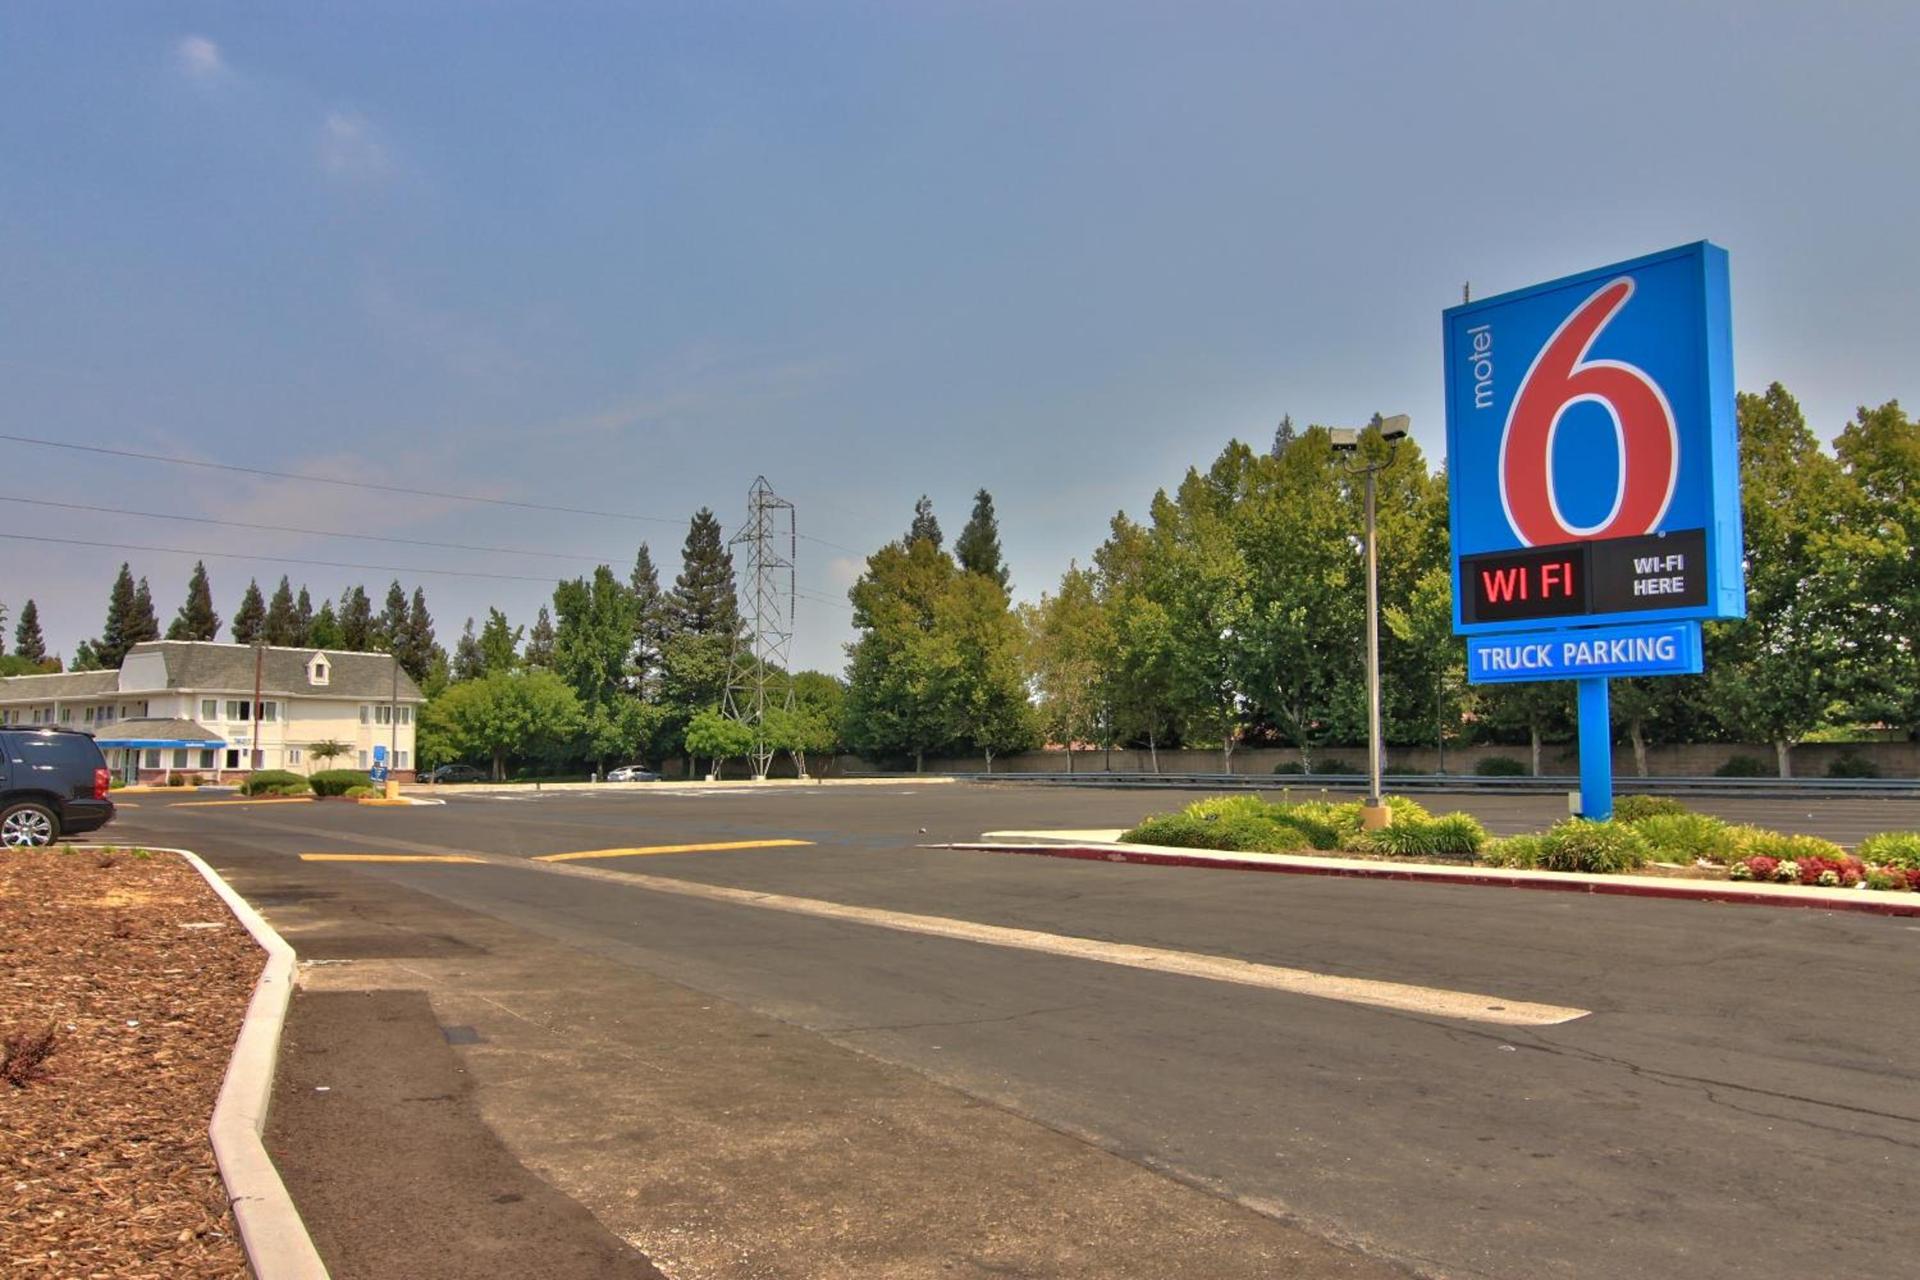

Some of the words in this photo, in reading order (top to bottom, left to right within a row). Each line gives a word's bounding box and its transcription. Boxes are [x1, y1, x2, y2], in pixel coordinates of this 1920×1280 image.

[1467, 325, 1493, 408] motel
[1498, 275, 1679, 547] 6
[1633, 554, 1684, 574] WI-FI
[1482, 567, 1528, 603] WI
[1541, 562, 1573, 598] FI
[1633, 576, 1684, 596] HERE
[1478, 644, 1553, 671] TRUCK
[1563, 635, 1675, 666] PARKING
